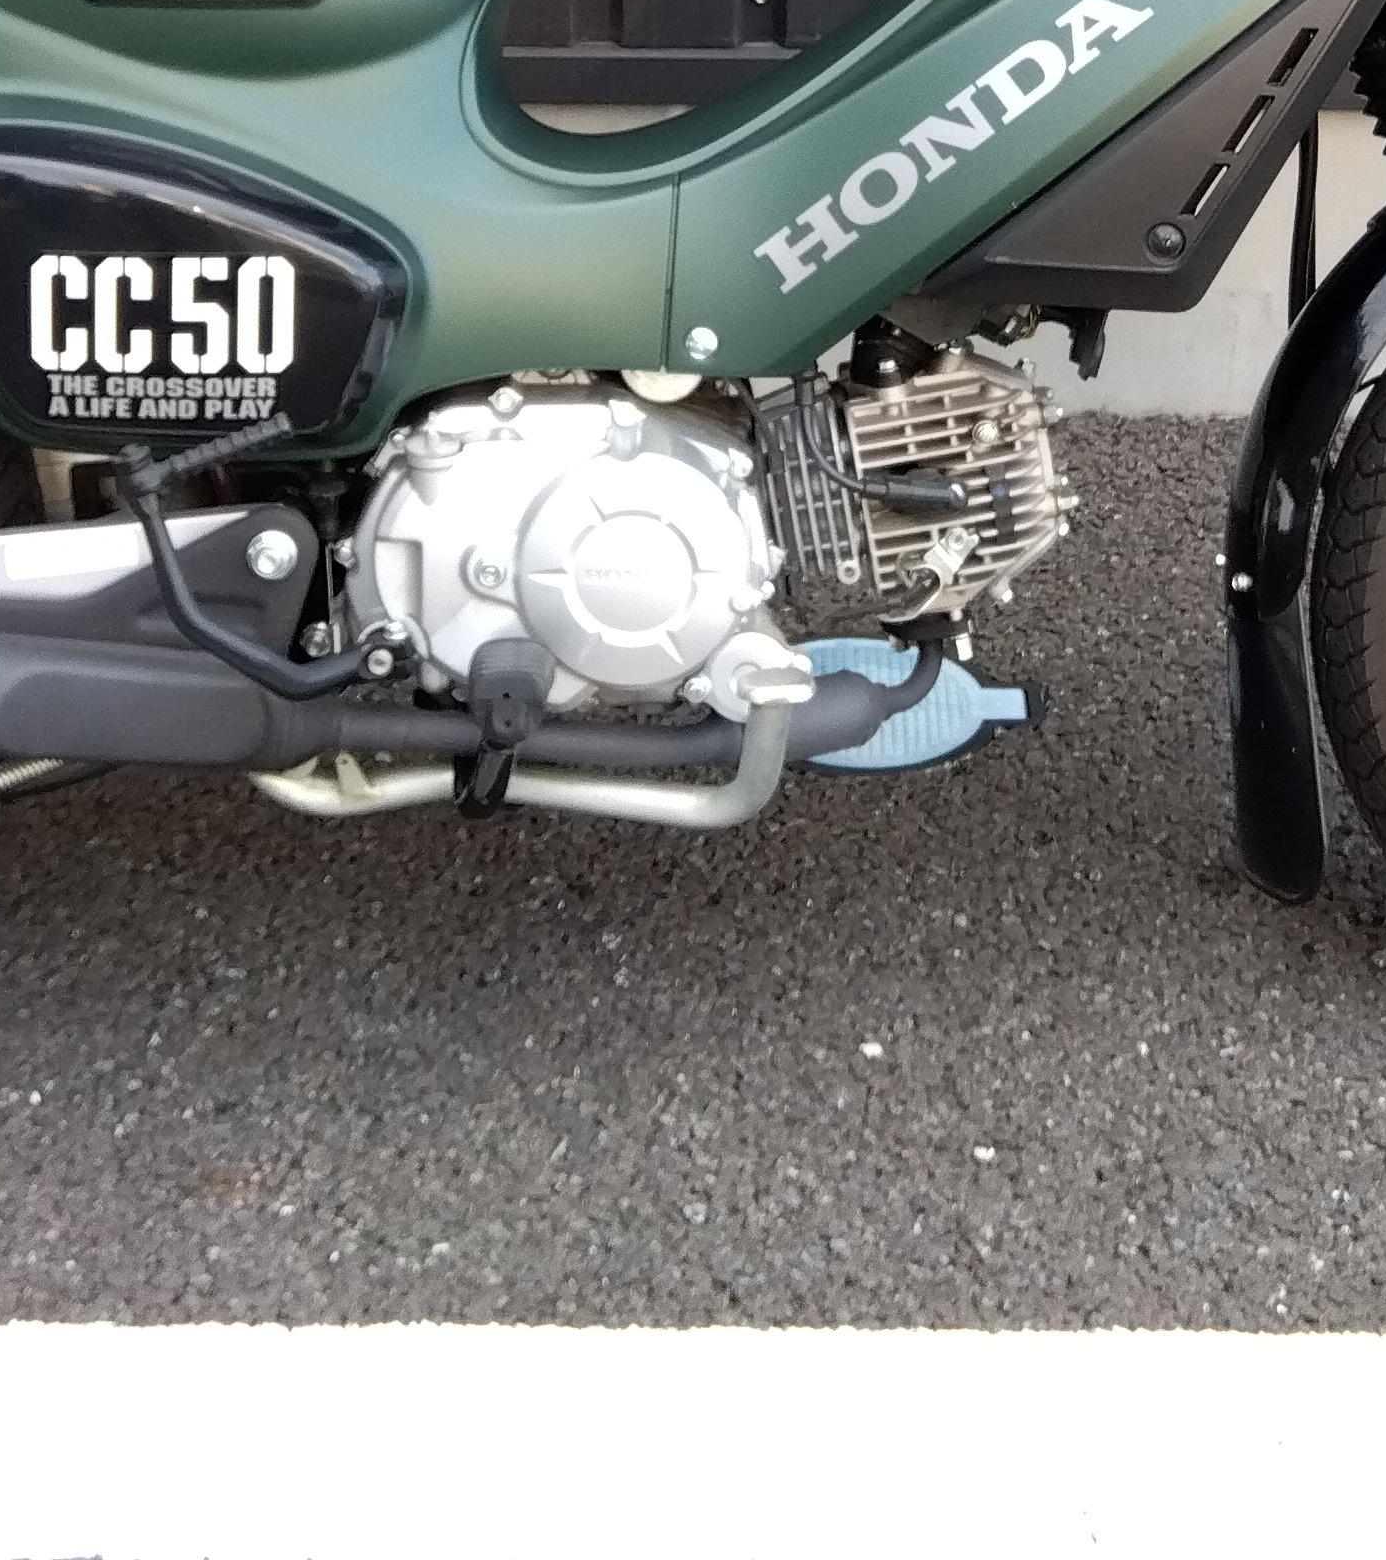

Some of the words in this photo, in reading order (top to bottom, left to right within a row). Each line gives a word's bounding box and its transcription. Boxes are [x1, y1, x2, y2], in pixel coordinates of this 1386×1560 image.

[46, 374, 99, 396] THE
[105, 376, 277, 398] CROSSOVER
[48, 395, 70, 418] A
[74, 396, 133, 419] LIFE
[137, 398, 198, 420] AND
[203, 398, 274, 421] PLAY
